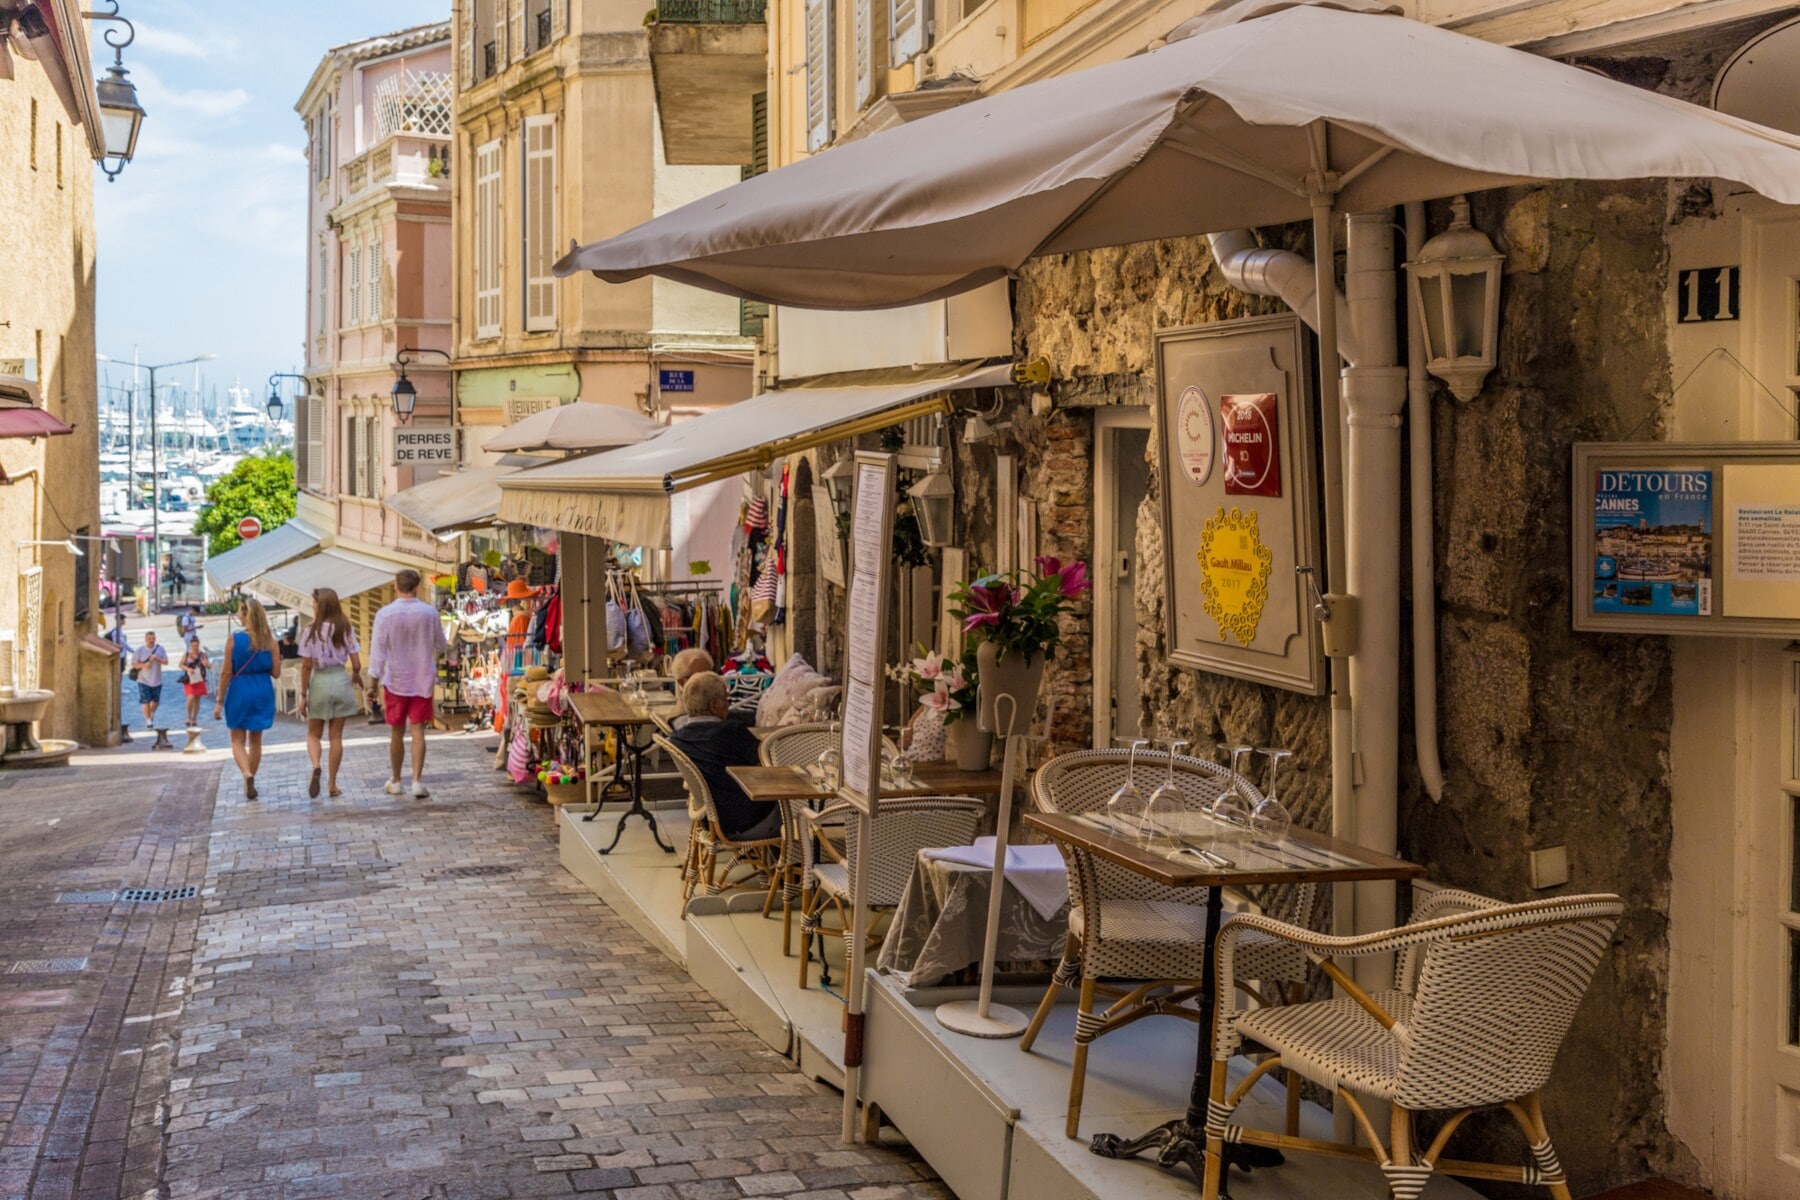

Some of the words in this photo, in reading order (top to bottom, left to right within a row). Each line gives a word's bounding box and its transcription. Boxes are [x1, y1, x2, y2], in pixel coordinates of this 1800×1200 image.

[1684, 268, 1734, 321] 11
[397, 433, 452, 445] PIERRES
[1227, 432, 1262, 443] MICHELIN
[397, 449, 415, 460] DE
[418, 448, 453, 460] REVE
[1658, 493, 1670, 501] en
[1674, 492, 1708, 501] France
[1222, 578, 1240, 588] 2017
